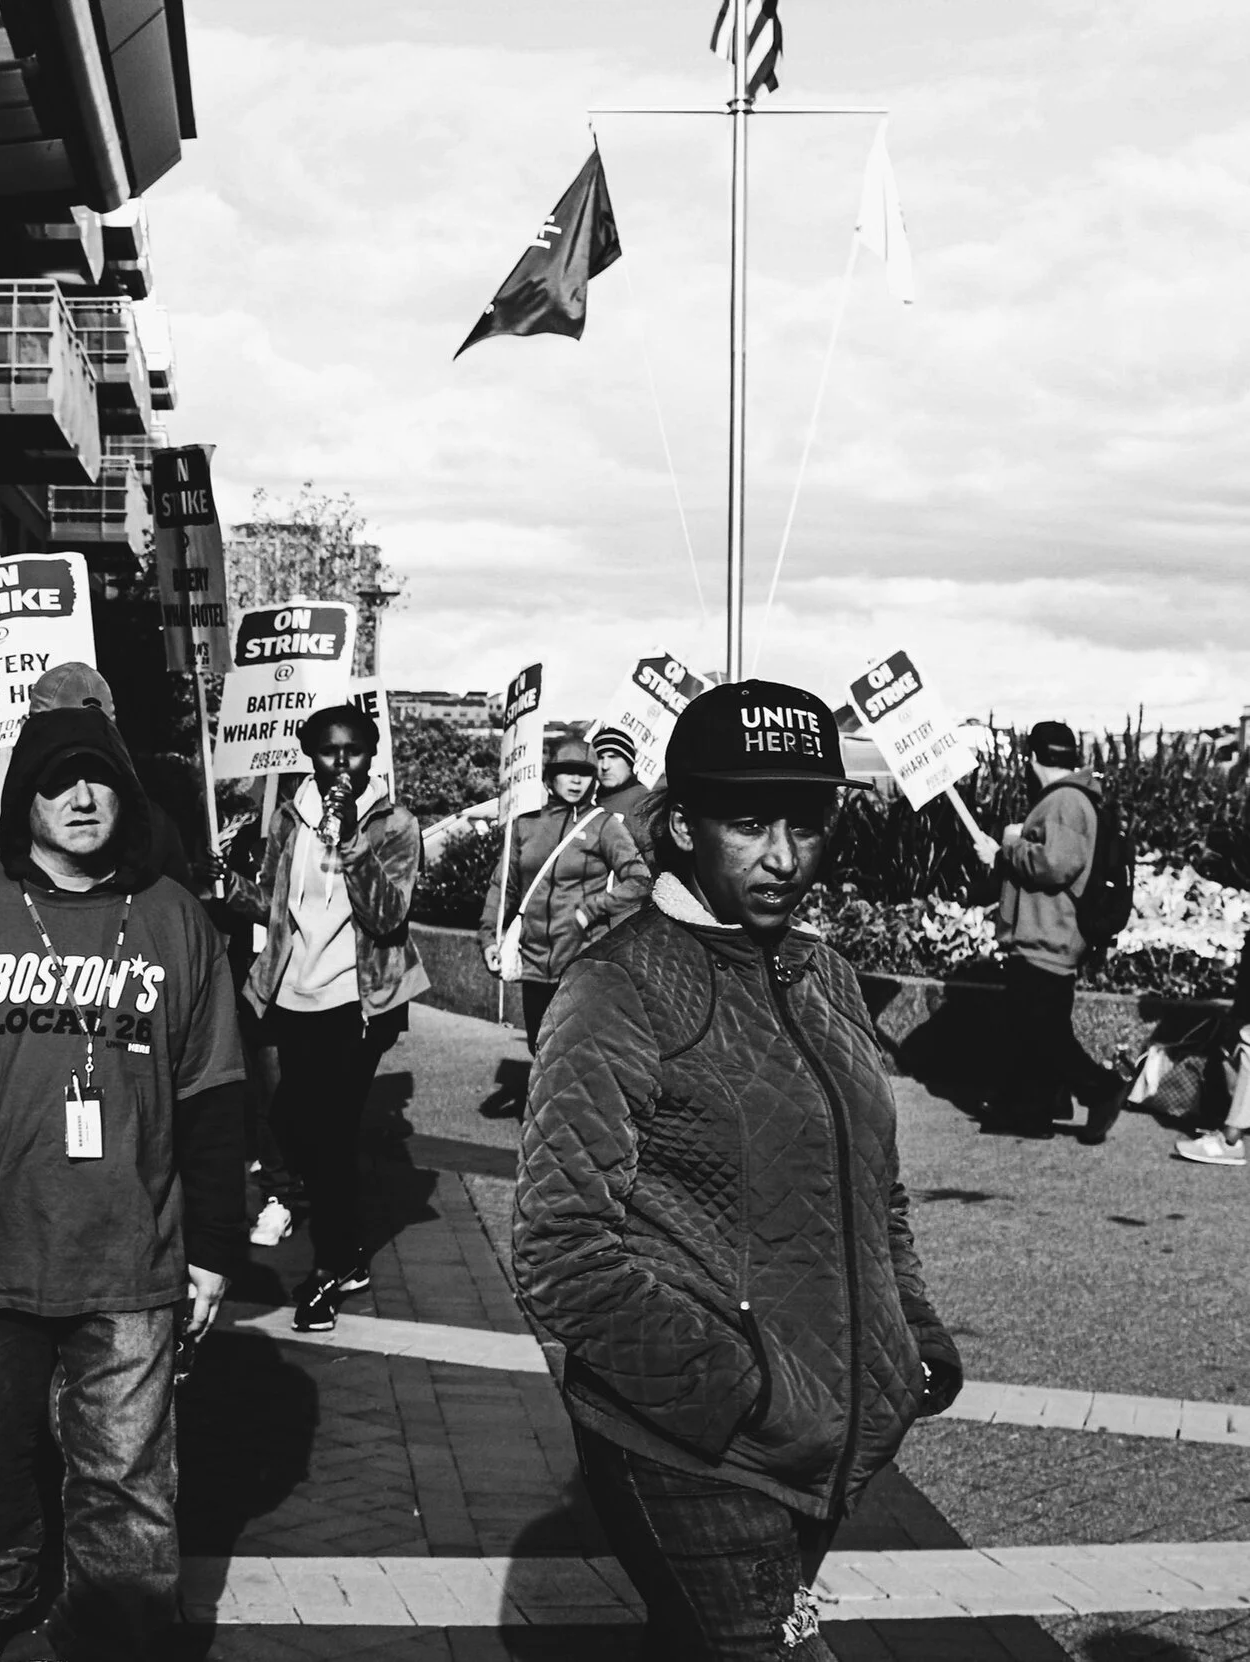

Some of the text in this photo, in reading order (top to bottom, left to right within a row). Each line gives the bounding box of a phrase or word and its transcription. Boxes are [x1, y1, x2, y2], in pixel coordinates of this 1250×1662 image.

[273, 608, 312, 631] ON
[244, 633, 336, 658] STRIKE
[273, 664, 295, 681] @
[867, 662, 895, 690] ON
[246, 692, 316, 713] BATTERY
[865, 671, 919, 718] STRIKE
[223, 720, 279, 743] WHARF
[740, 706, 820, 733] UNITE
[744, 731, 824, 758] HERE!
[635, 751, 657, 776] OTEL
[115, 1014, 153, 1044] 26
